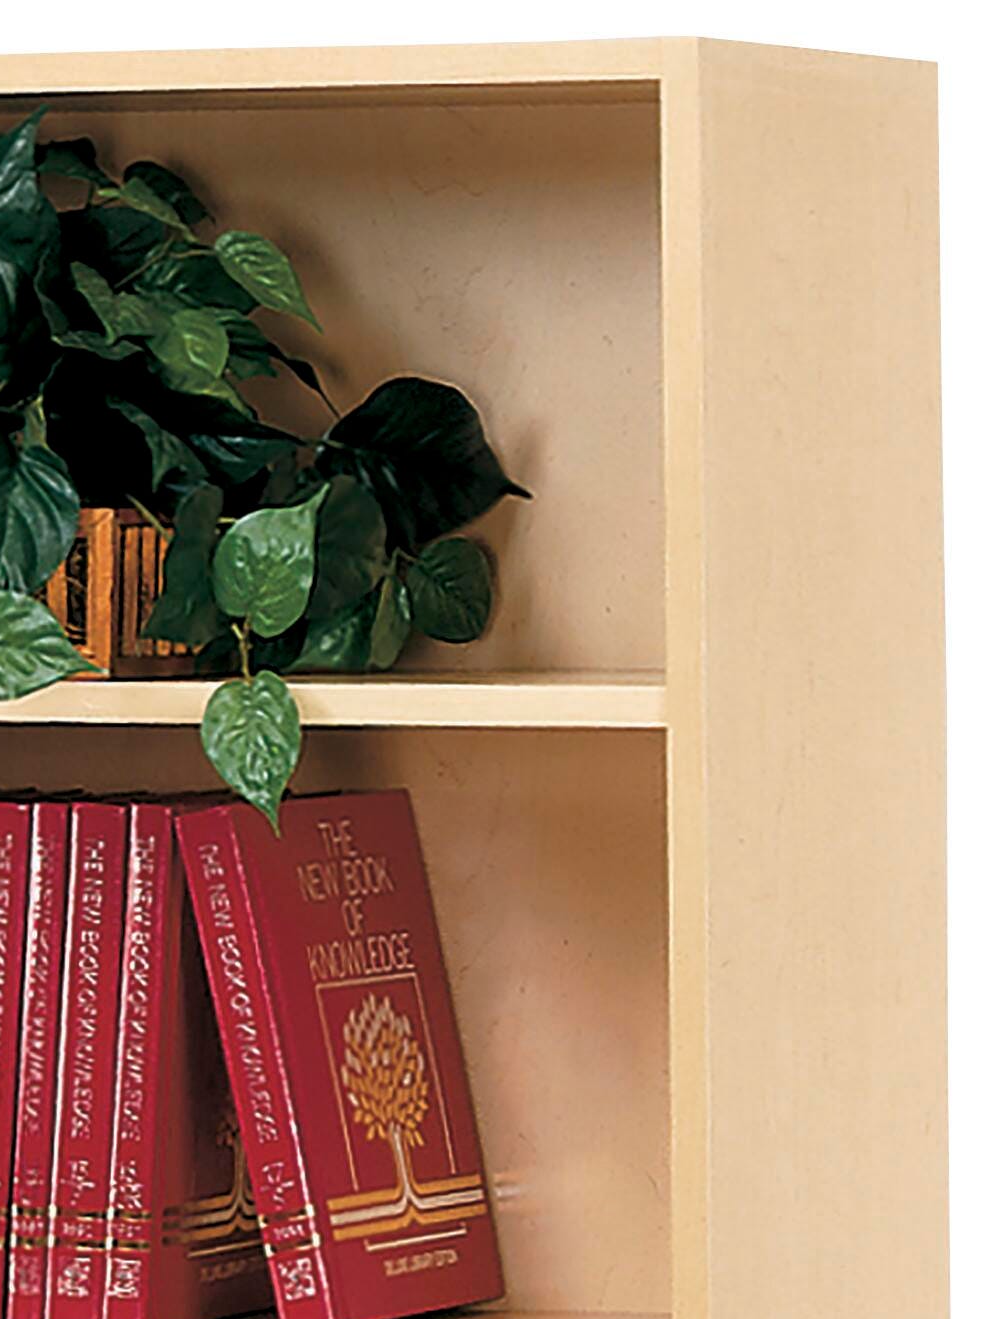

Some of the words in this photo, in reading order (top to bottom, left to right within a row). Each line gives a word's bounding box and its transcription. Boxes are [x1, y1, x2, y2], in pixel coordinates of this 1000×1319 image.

[83, 839, 105, 872] THE
[317, 820, 358, 857] THE
[197, 844, 224, 880] THE
[296, 862, 340, 901] NEW
[341, 857, 395, 896] BOOK
[81, 877, 103, 924] NEW
[132, 879, 153, 925] NEW
[207, 882, 236, 928] NEW
[341, 898, 363, 936] OF
[77, 930, 100, 985] BOOK
[215, 934, 247, 988] BOOK
[306, 931, 416, 981] KNOWLEDGE
